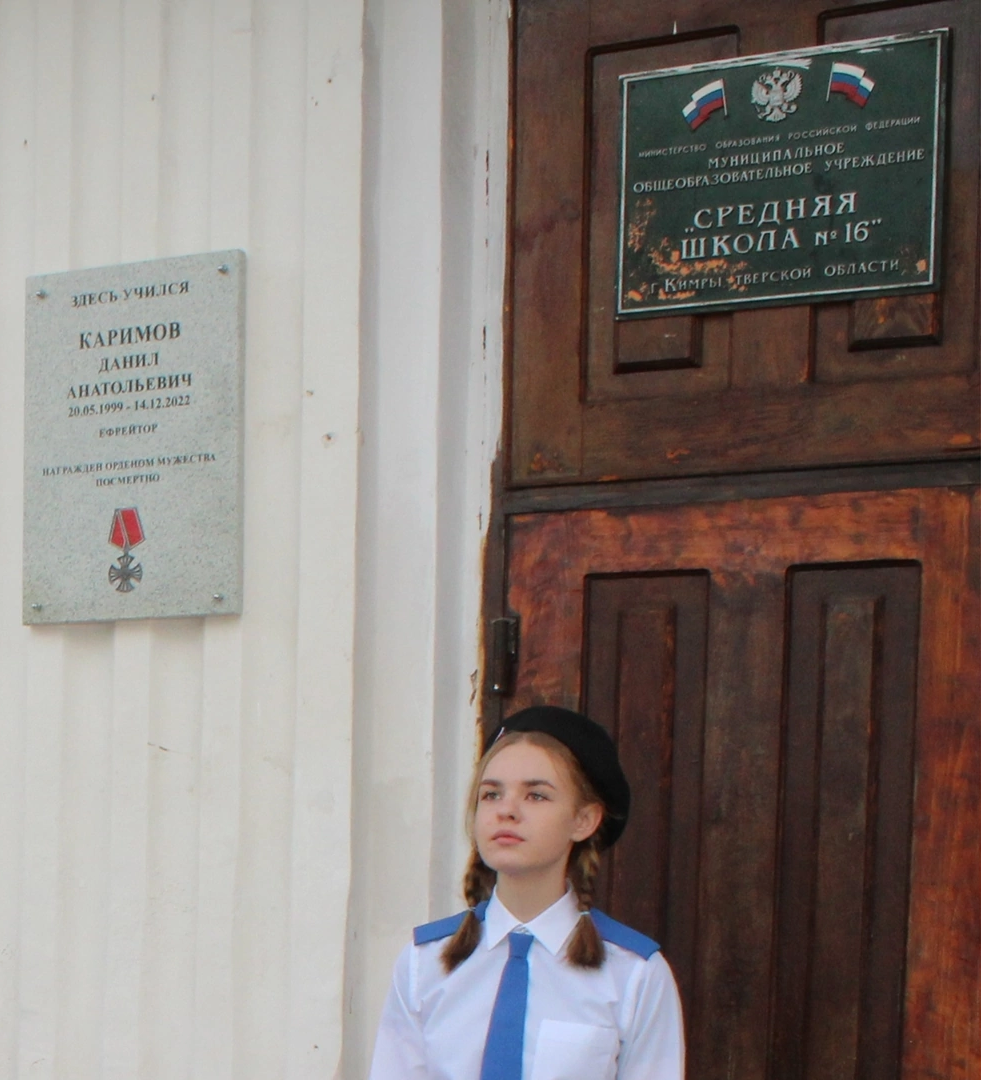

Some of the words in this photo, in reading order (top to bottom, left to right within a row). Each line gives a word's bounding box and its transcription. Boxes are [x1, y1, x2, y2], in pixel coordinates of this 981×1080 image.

[638, 143, 708, 159] МИНИСТЕРСТВО
[715, 133, 781, 150] ОБРАЗОВАНИЯ
[787, 124, 858, 141] РОССИЙСКОЙ
[864, 115, 922, 132] ФЕДЕРАЦИИ
[707, 142, 846, 170] МУНИЦИПАЛЬНОЕ
[632, 162, 813, 194] ОБЩЕОБРАЗОВАТЕЛЬНОЕ
[823, 148, 926, 172] УЧРЕЖДЕНИЕ
[680, 227, 801, 261] ШКОЛА
[735, 267, 812, 286] ТВЕРСКОЙ
[823, 258, 900, 278] ОБЛАСТИ
[71, 290, 118, 309] ЗДЕСЬ
[123, 280, 190, 301] УЧИЛСЯ
[79, 321, 181, 350] КАРИМОВ
[98, 352, 160, 374] ДАНИЛ
[67, 373, 193, 400] АНАТОЛЬЕВИЧ
[68, 401, 124, 418] 20.05.1999
[134, 394, 191, 411] 14.12.2022
[99, 423, 159, 438] ЕФРЕЙТОР
[42, 462, 103, 477] НАГРАЖДЕН
[105, 457, 155, 472] ОРДЕНОМ
[156, 452, 217, 467] МУЖЕСТВА
[95, 473, 161, 488] ПОСМЕРТНО
